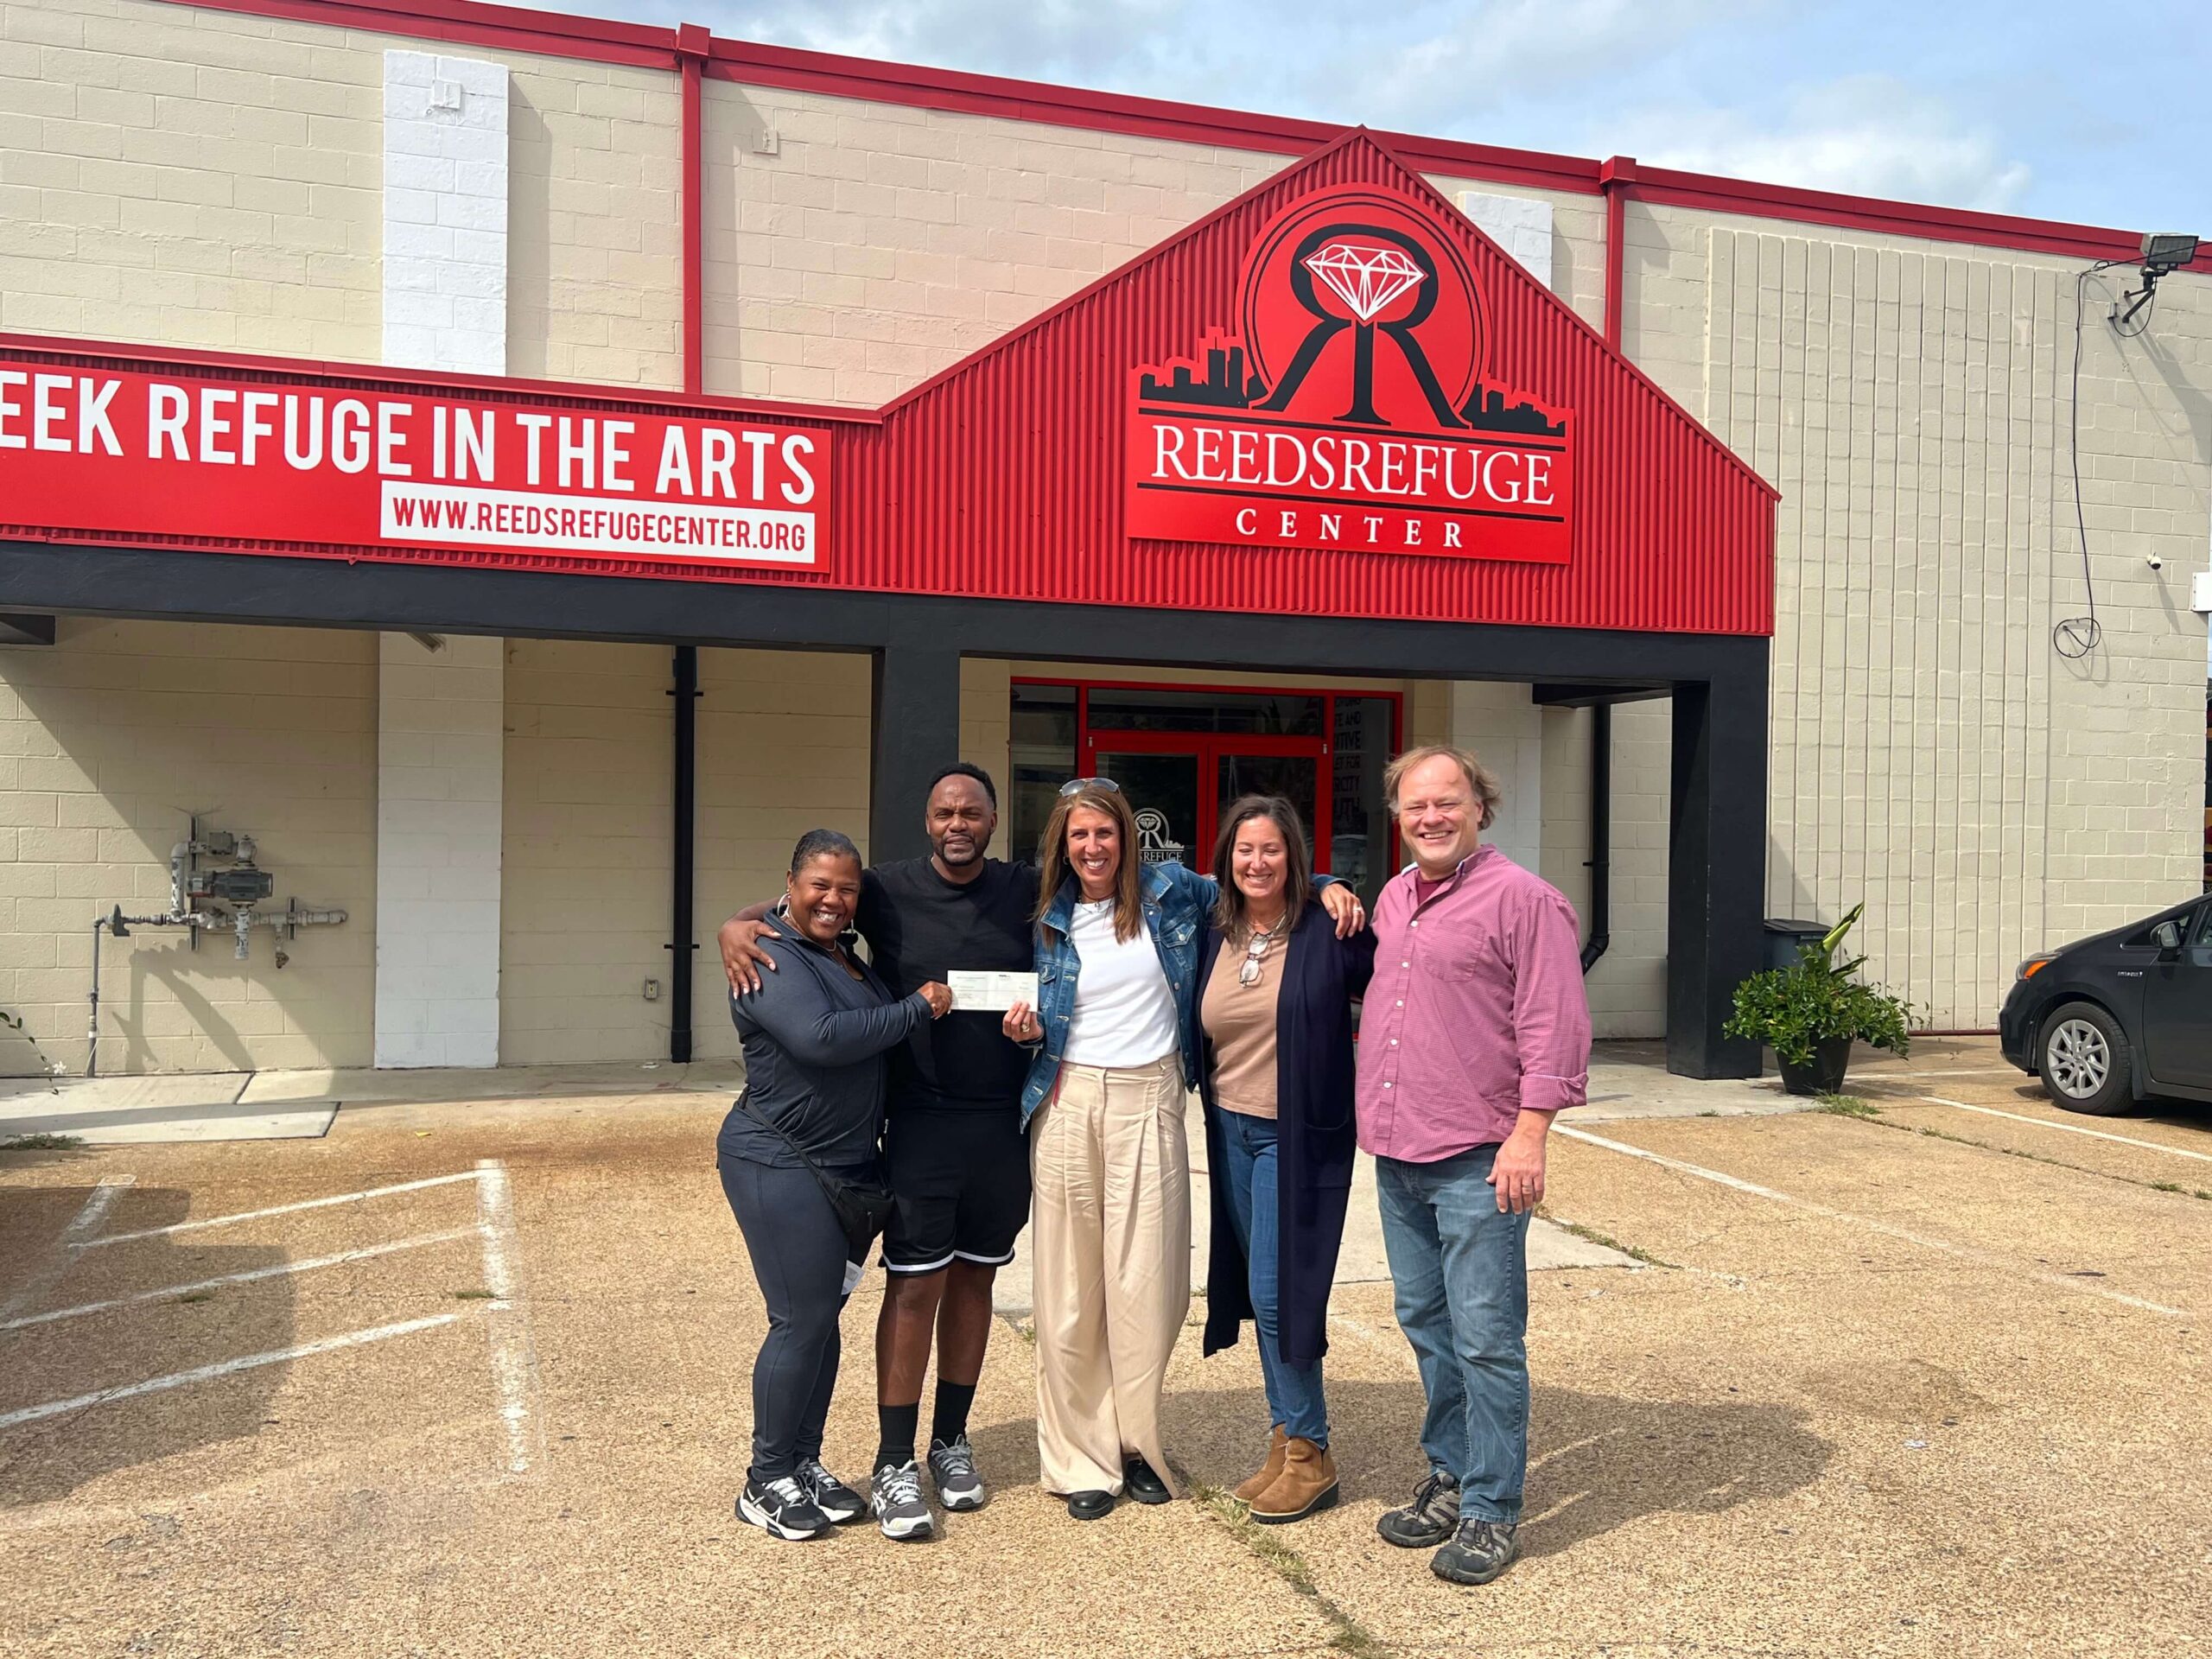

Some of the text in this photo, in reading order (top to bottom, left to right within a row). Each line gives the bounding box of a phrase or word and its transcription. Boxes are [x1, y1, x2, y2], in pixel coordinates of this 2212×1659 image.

[0, 370, 815, 505] EEK REFUGE IN THE ARTS
[1151, 424, 1554, 505] REEDSREFUGE
[392, 497, 805, 552] WWW.REEDSREFUGECENTER.ORG
[1236, 508, 1462, 548] CENTER
[1333, 730, 1362, 750] ITIVE
